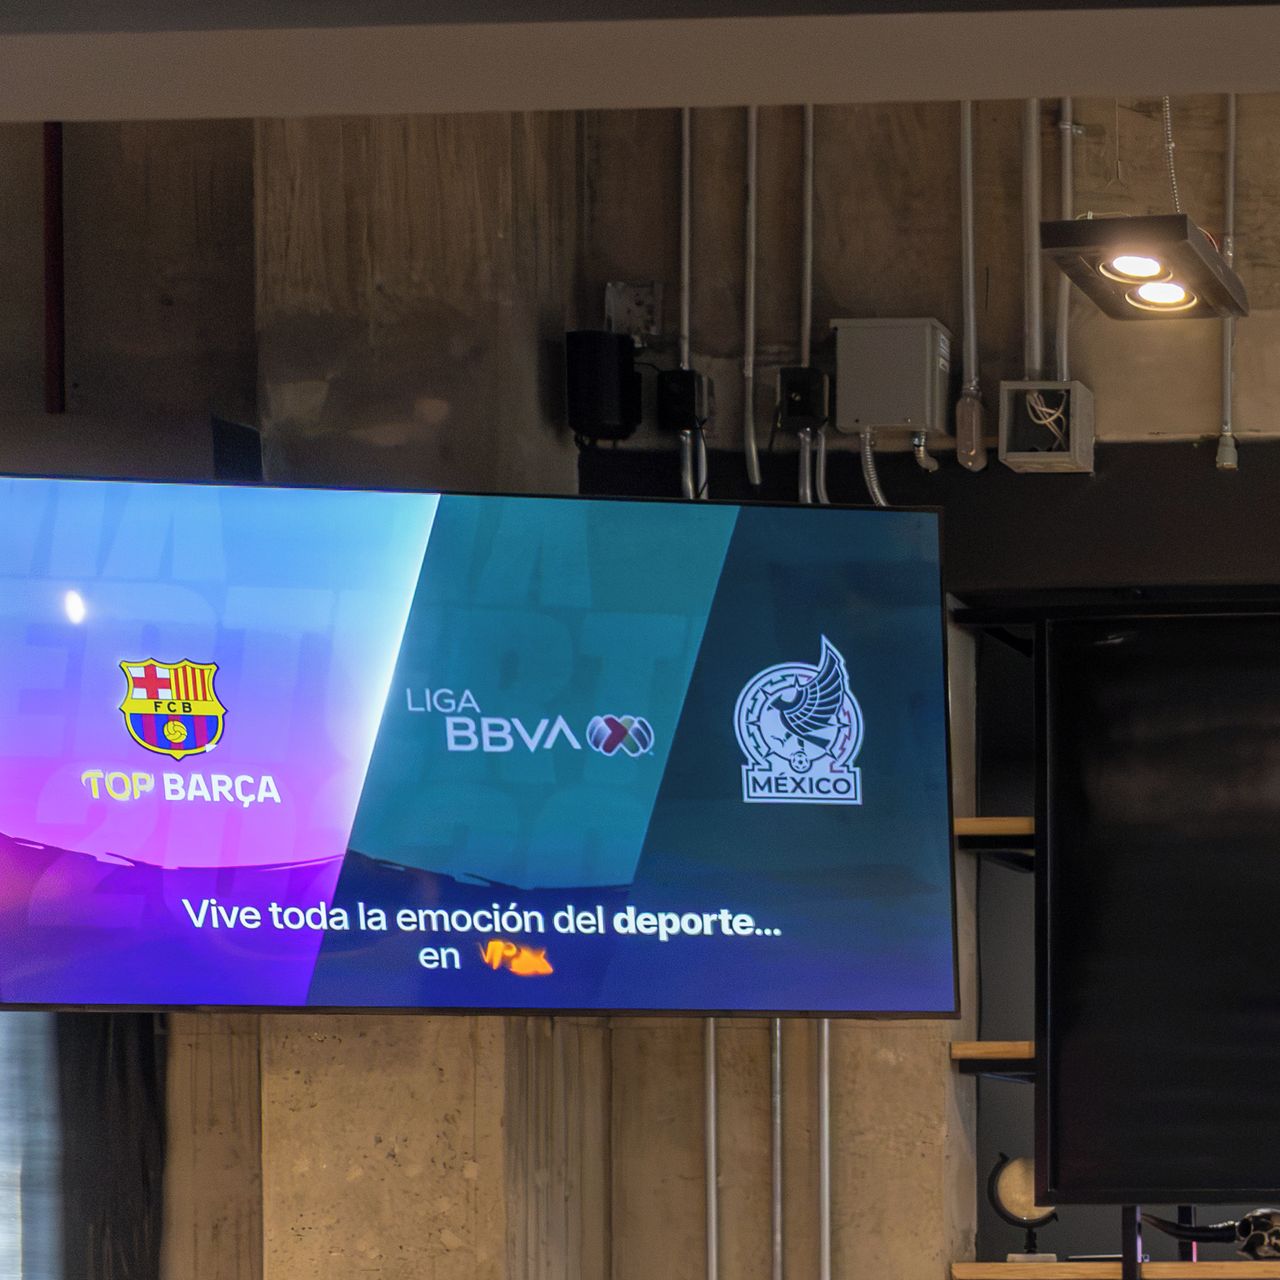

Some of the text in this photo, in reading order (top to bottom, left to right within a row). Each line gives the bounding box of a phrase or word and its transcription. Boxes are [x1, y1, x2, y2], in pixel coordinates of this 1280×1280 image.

[406, 688, 481, 713] LIGA
[445, 715, 582, 753] BBVA
[81, 769, 281, 807] TOP BARÇA
[751, 771, 852, 795] MÉXICO
[182, 898, 783, 942] Vive toda la emoción del deporte...
[418, 946, 462, 969] en
